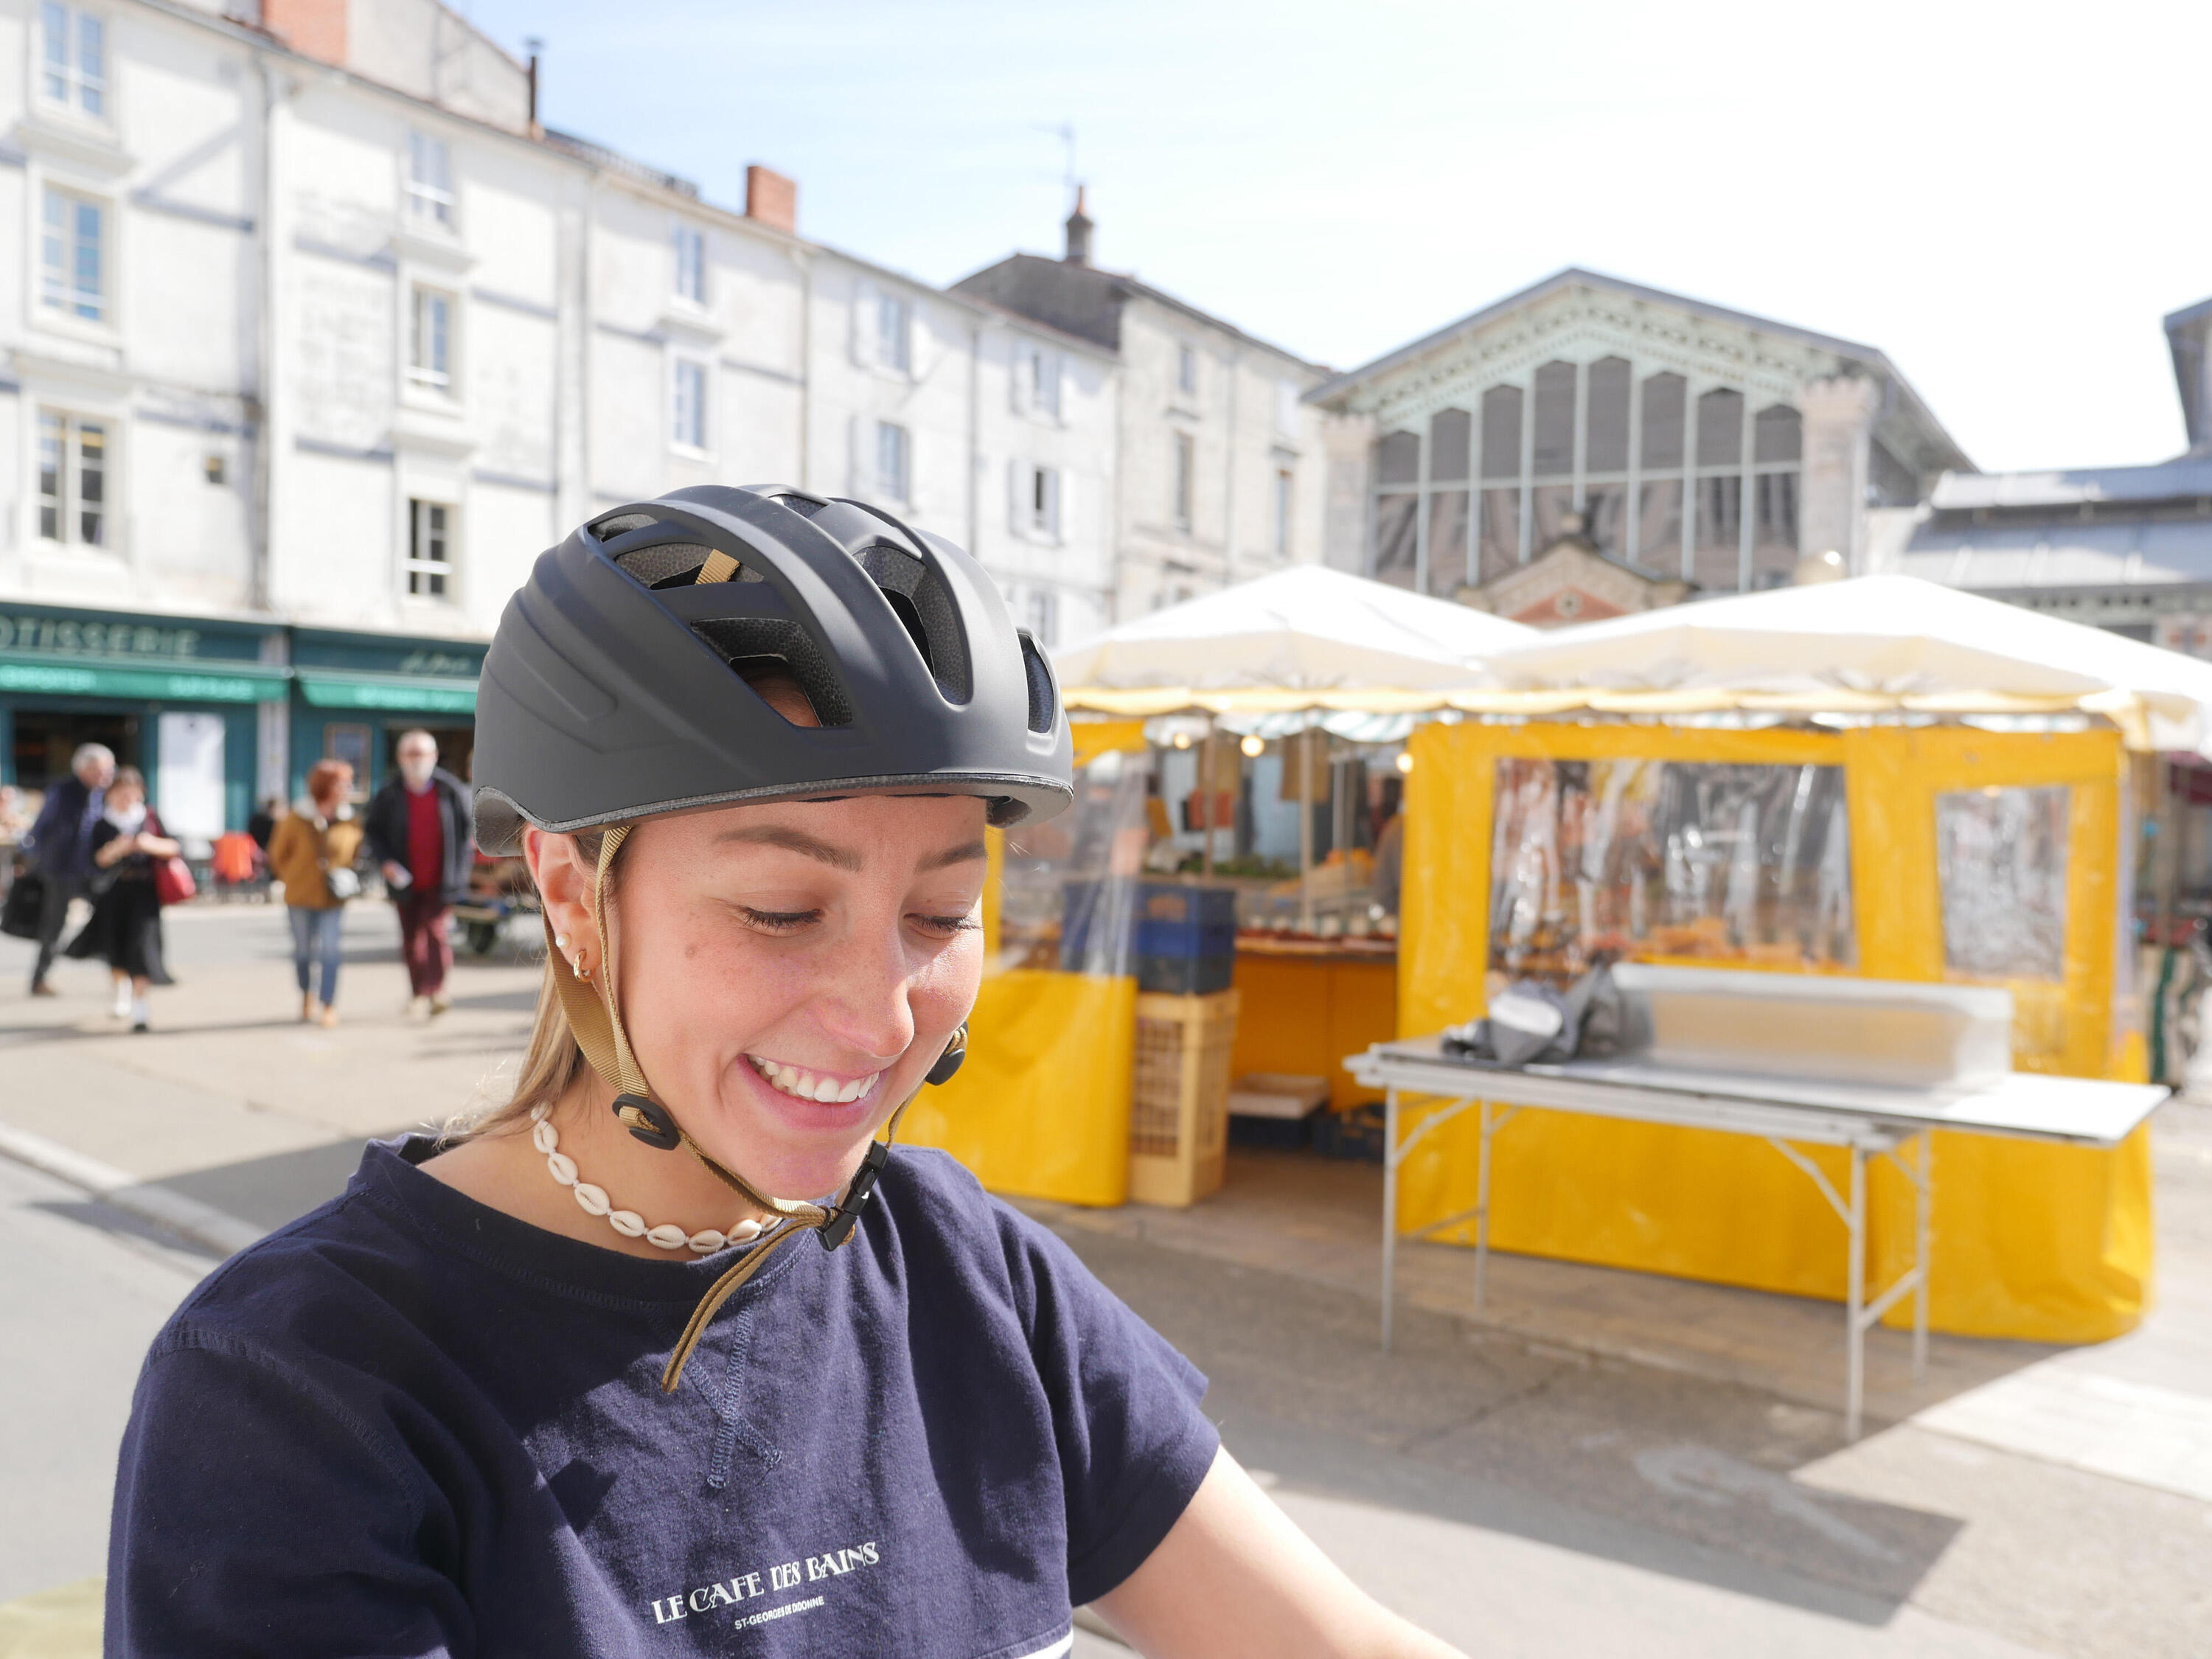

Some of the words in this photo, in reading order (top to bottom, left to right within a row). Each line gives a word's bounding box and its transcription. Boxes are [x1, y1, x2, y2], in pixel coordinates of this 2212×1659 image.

[652, 1594, 687, 1624] LE
[689, 1571, 765, 1613] CAFE
[770, 1561, 803, 1591] DES
[806, 1541, 880, 1582] BAINS
[734, 1607, 785, 1630] ST-GEORGES
[785, 1604, 793, 1615] DE
[792, 1596, 824, 1614] DIDONNE
